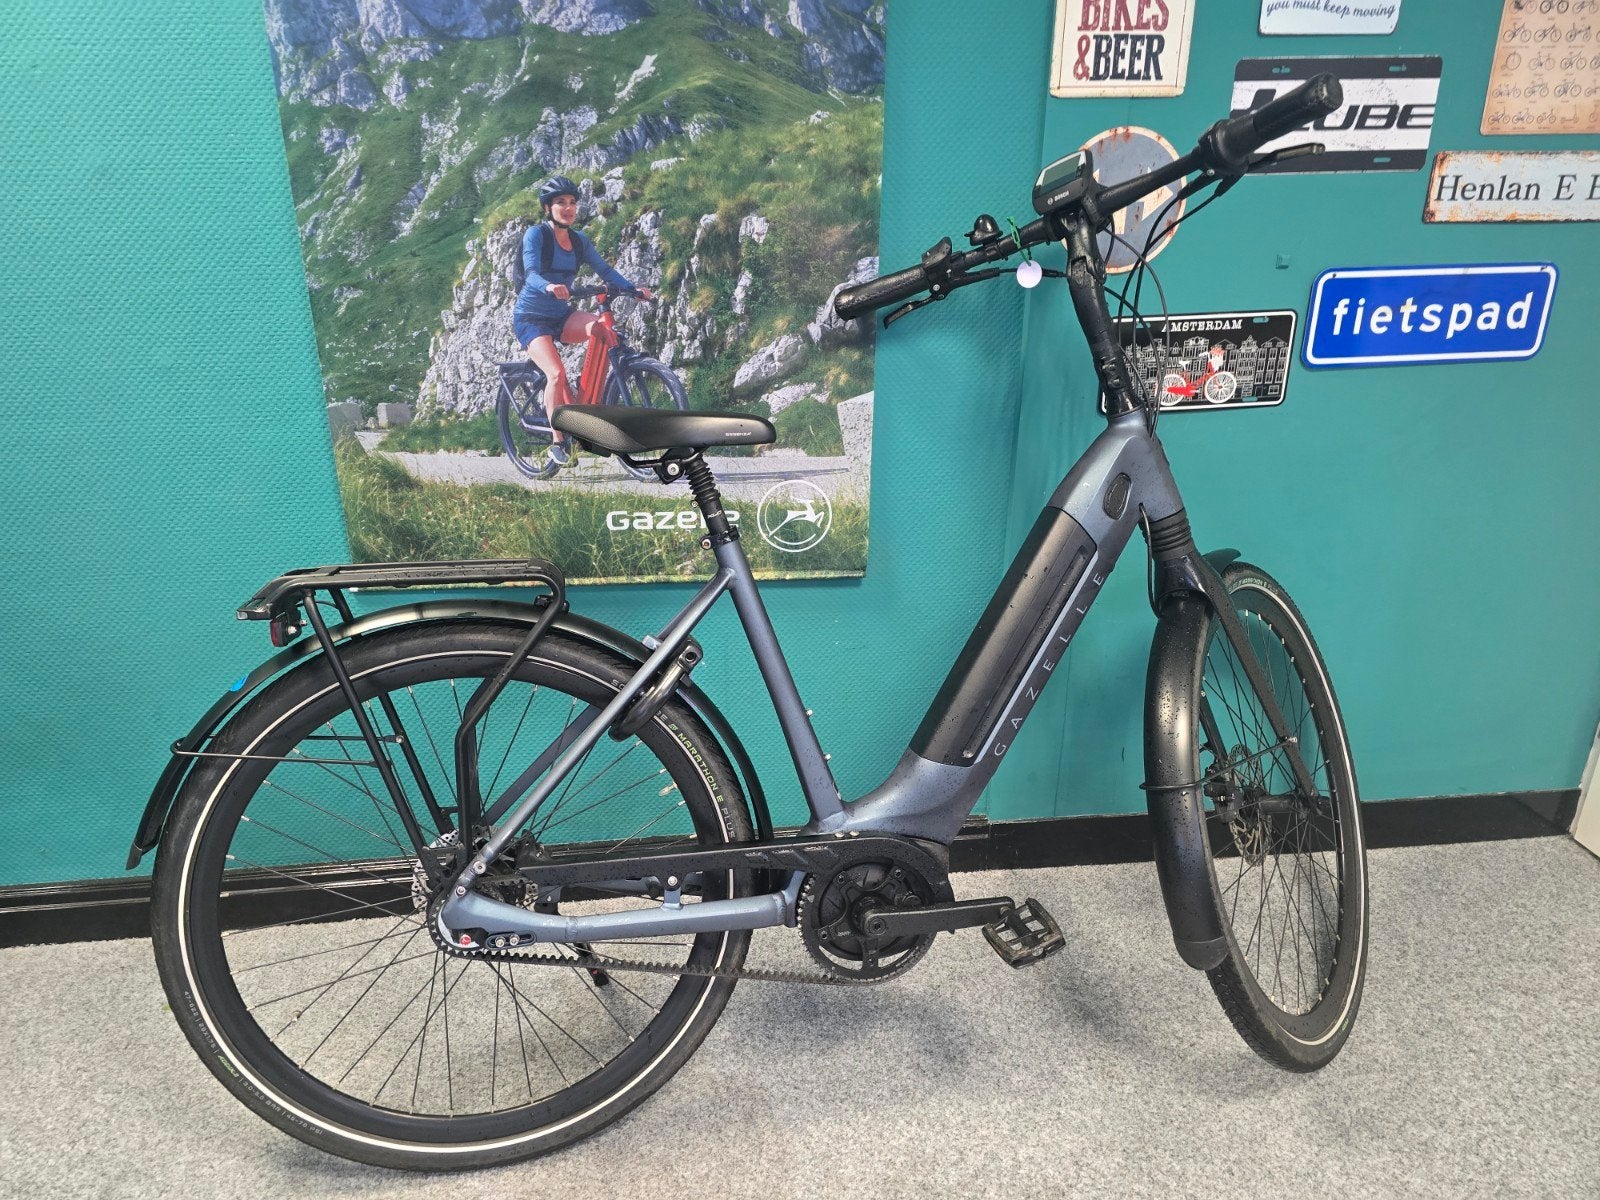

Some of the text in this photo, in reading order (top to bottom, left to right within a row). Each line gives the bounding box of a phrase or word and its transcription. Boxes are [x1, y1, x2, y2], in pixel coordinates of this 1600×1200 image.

[1077, 0, 1169, 31] BIKES
[1266, 0, 1290, 17] you
[1323, 1, 1351, 19] keep
[1353, 4, 1396, 19] moving
[1297, 104, 1436, 131] UBE
[1434, 174, 1541, 201] Henlan
[1552, 174, 1577, 201] E
[1332, 291, 1534, 340] fietspad
[993, 572, 1104, 757] GAZELLE
[677, 732, 719, 791] MARATHON
